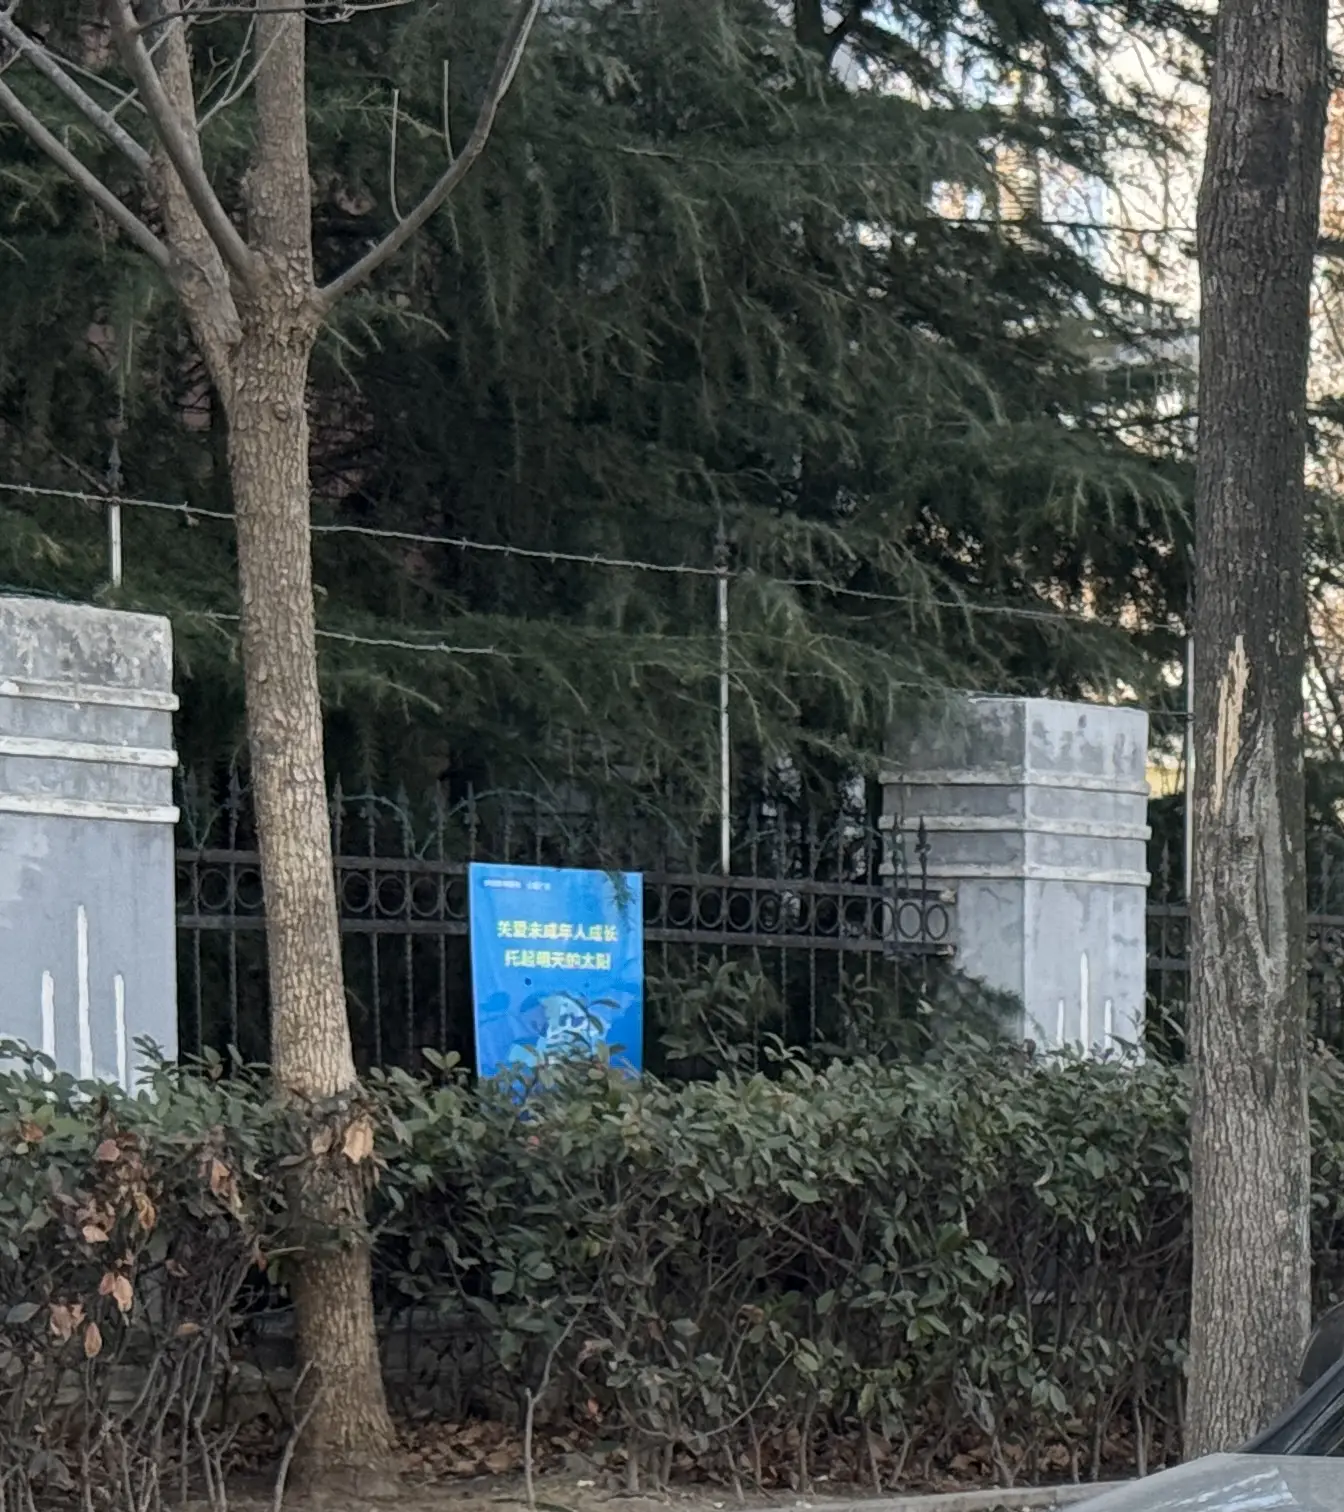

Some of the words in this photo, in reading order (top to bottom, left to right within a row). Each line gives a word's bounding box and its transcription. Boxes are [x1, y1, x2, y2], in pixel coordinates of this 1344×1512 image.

[497, 920, 618, 942] 关爱未成年人成长
[504, 949, 612, 970] 托起明天的太阳
